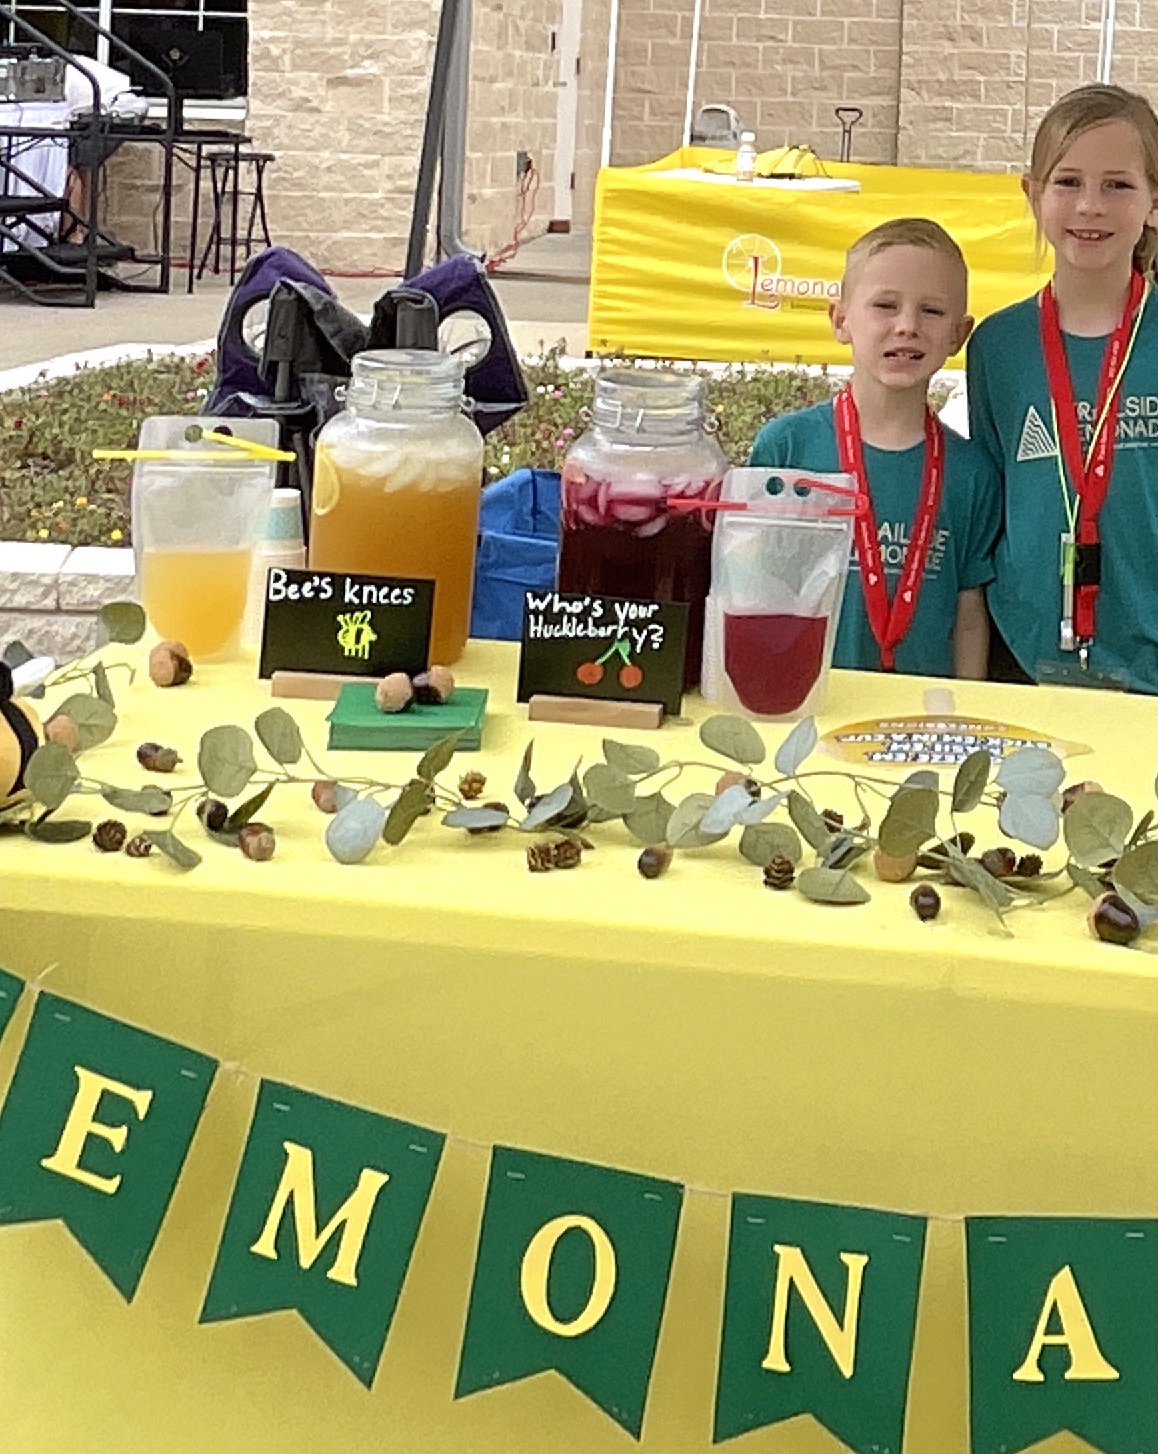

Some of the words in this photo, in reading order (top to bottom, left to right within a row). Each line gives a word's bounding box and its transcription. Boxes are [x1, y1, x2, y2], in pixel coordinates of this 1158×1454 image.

[743, 255, 841, 309] Lemona
[268, 568, 334, 602] Bee's
[344, 576, 415, 606] knees
[526, 592, 604, 618] Who's
[614, 601, 660, 626] your
[528, 614, 664, 654] Huckleberry?
